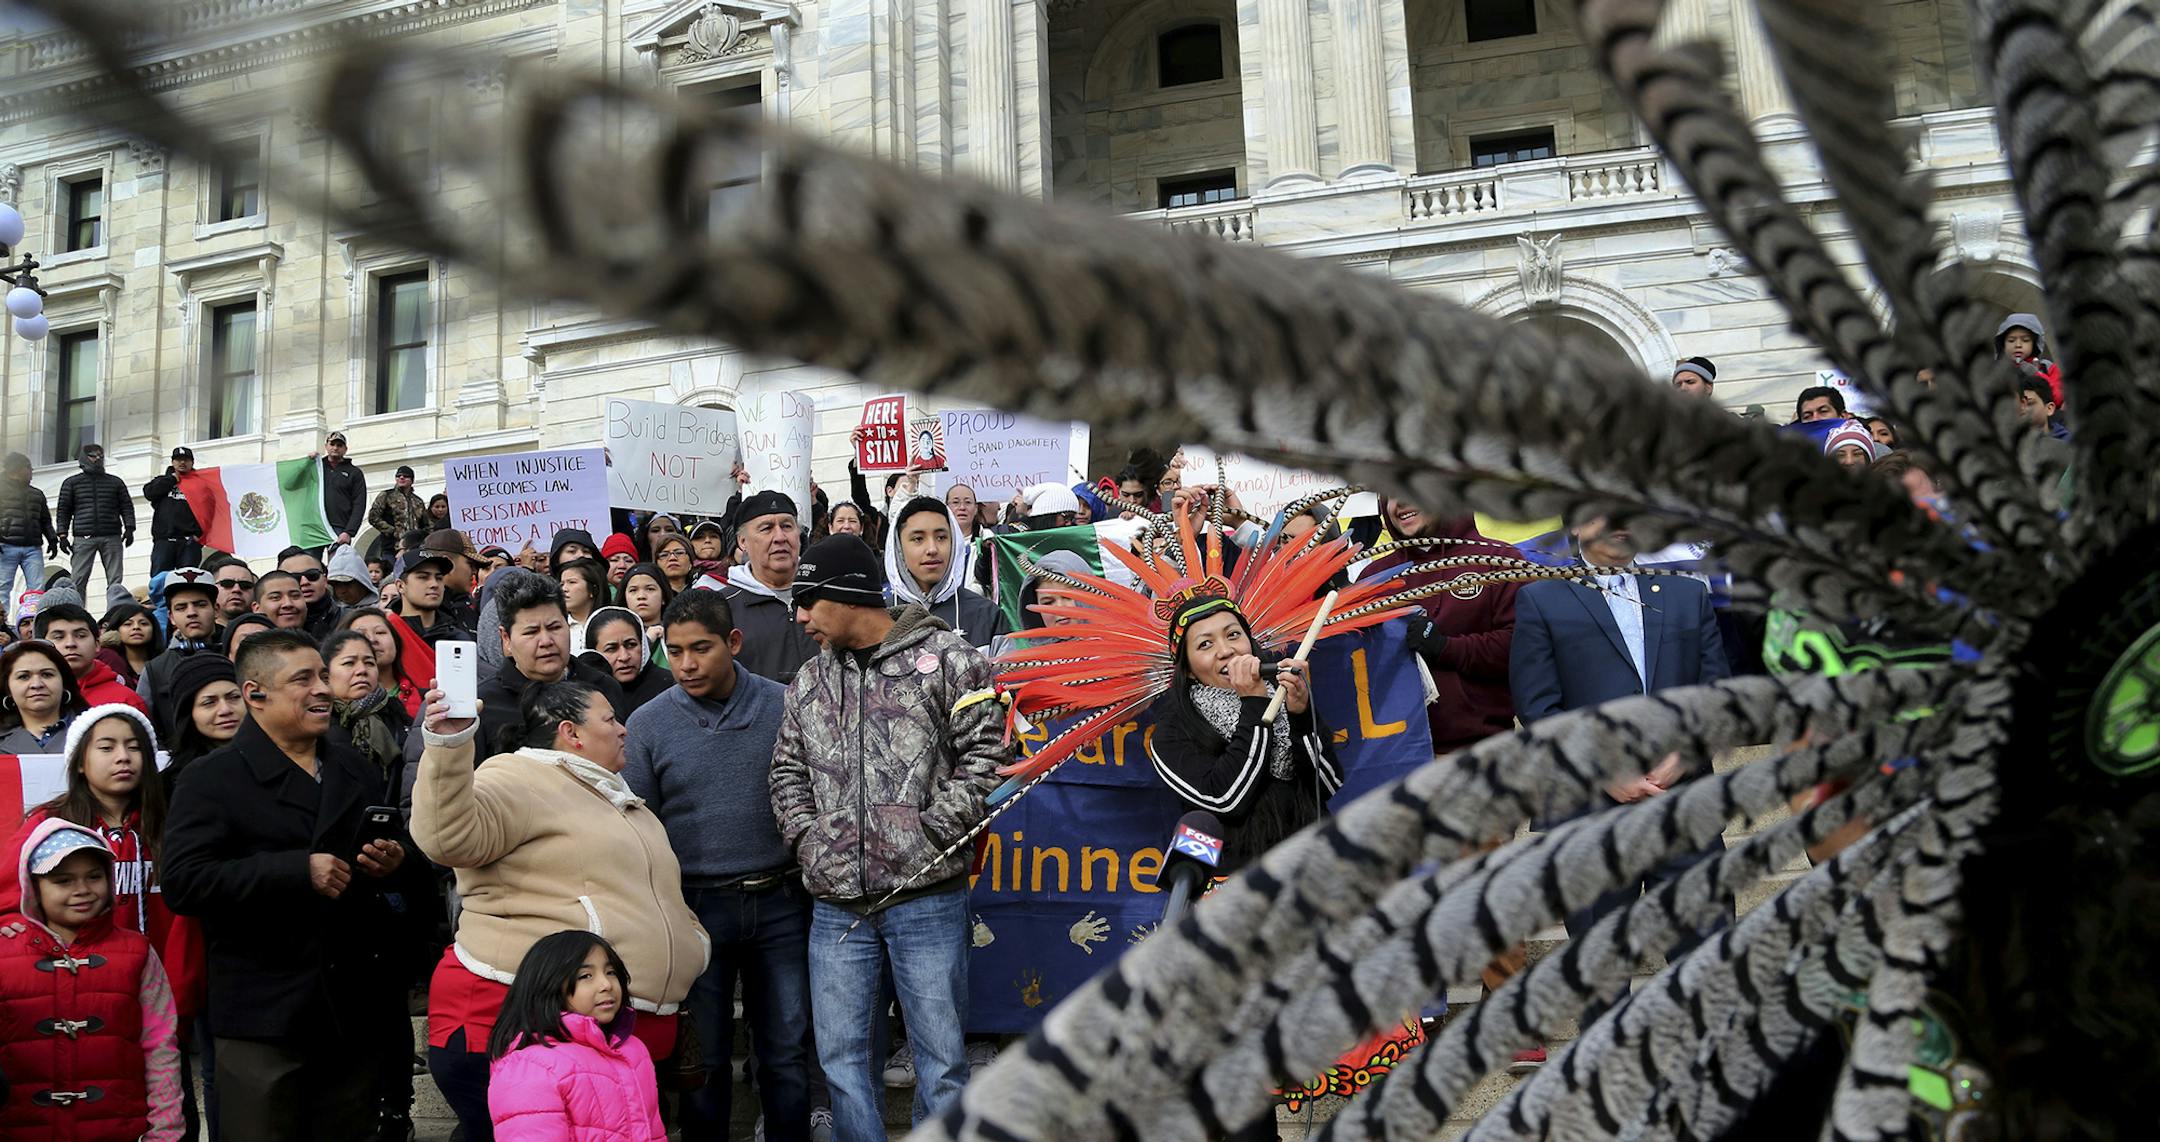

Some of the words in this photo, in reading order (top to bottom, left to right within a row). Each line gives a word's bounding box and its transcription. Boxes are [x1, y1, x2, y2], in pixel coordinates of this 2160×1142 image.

[738, 392, 768, 423] WE
[865, 401, 899, 425] HERE
[609, 400, 667, 439] Build
[678, 411, 738, 456] Bridges
[875, 425, 887, 439] TO
[946, 411, 1015, 436] PROUD
[745, 430, 776, 459] RUN
[865, 440, 899, 465] STAY
[968, 437, 1004, 457] GRAND
[1008, 438, 1061, 451] DAUGHTER
[453, 461, 499, 481] WHEN
[516, 456, 586, 475] INJUSTICE
[651, 452, 704, 479] NOT
[769, 453, 800, 471] BUT
[991, 459, 1000, 469] A
[478, 480, 537, 498] BECOMES
[545, 479, 573, 492] LAW.
[618, 472, 701, 506] Walls
[952, 472, 1050, 489] IMMIGRANT
[461, 500, 551, 523] RESISTANCE
[531, 523, 541, 539] A
[1185, 827, 1217, 848] FOX
[1187, 841, 1208, 857] 9
